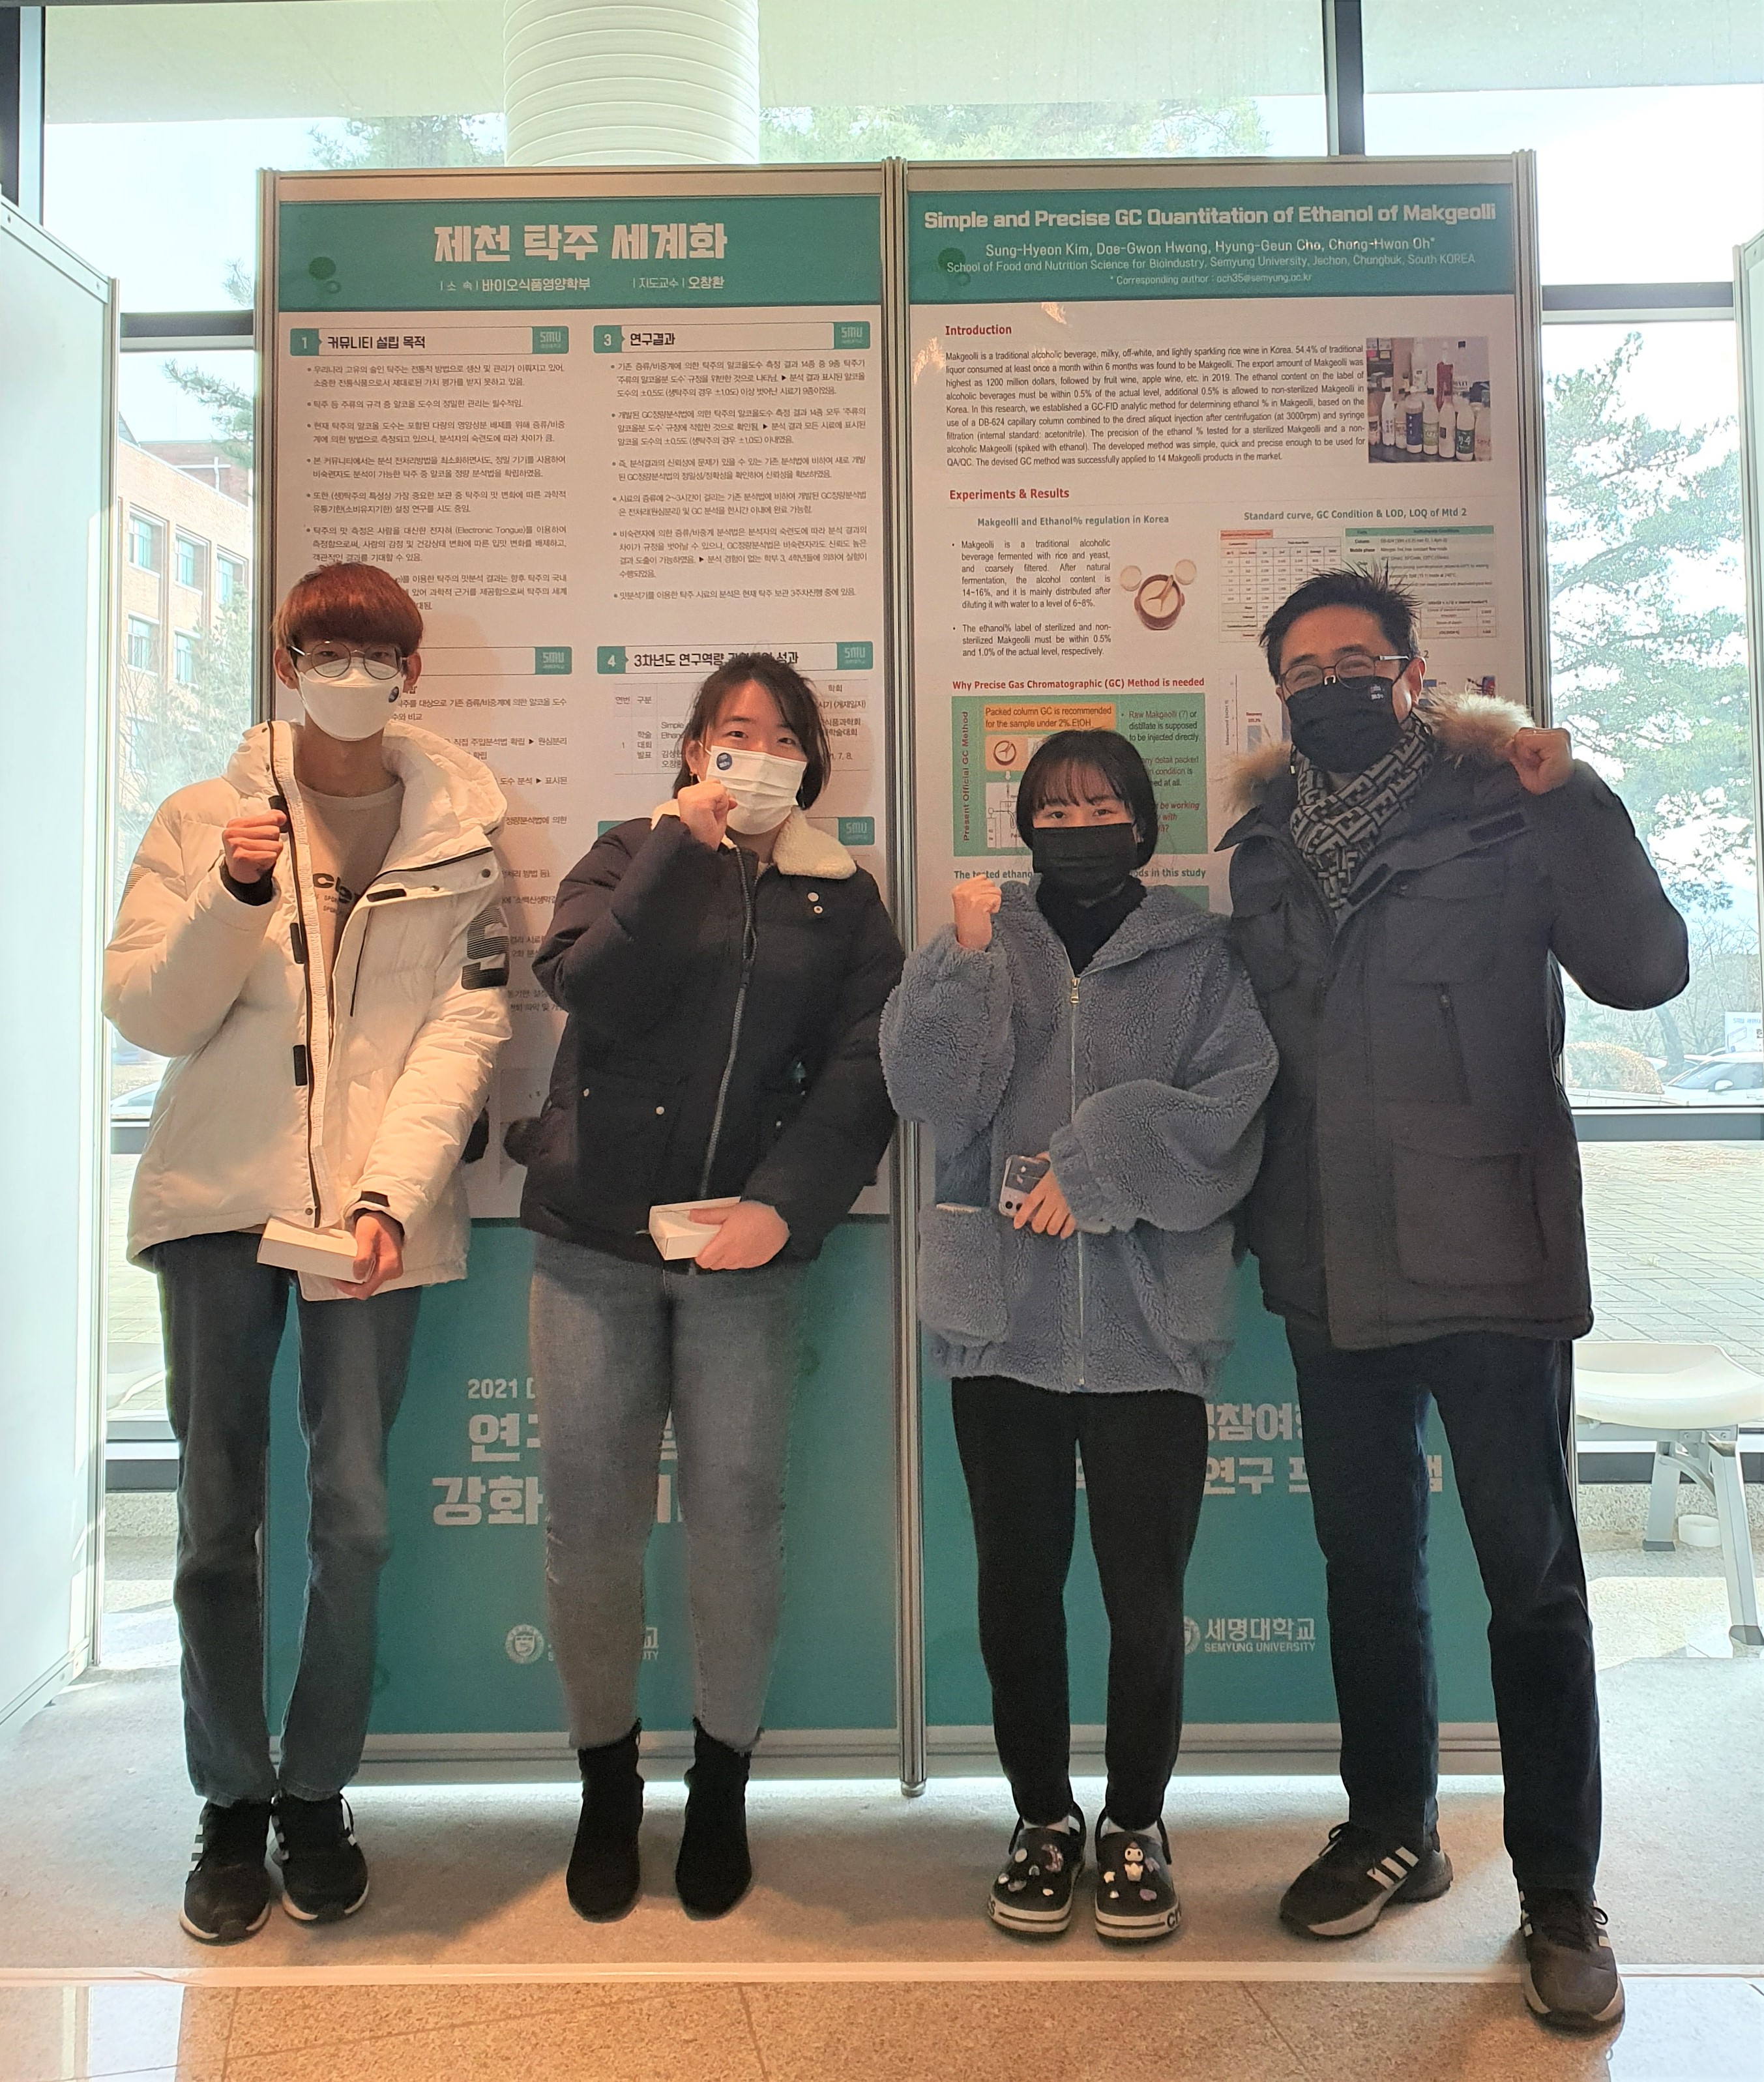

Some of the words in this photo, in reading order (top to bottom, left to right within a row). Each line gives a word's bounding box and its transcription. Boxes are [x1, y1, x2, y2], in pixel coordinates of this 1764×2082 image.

[924, 210, 988, 233] Simple
[993, 209, 1030, 228] and
[1035, 209, 1110, 227] Precise
[1115, 209, 1142, 226] GC
[1147, 206, 1269, 226] Quantitation
[1273, 205, 1294, 224] of
[1299, 204, 1374, 223] Ethanol
[1377, 204, 1398, 222] of
[1403, 203, 1496, 226] Makgeolli
[434, 224, 510, 263] 제천
[524, 224, 598, 261] 탁주
[611, 222, 728, 260] 세계화
[986, 242, 1062, 259] Sung-Hyeon
[1066, 242, 1093, 257] Kim,
[1096, 241, 1162, 256] Dae-Gwon
[1165, 240, 1211, 256] Hwang,
[1215, 239, 1293, 256] Hyung-Geun
[1297, 238, 1325, 252] Cho,
[1329, 237, 1409, 253] Chang-Hwan
[947, 259, 980, 273] School
[982, 260, 993, 272] of
[996, 260, 1022, 272] Food
[1023, 260, 1042, 272] and
[1044, 259, 1088, 272] Nutrition
[1090, 259, 1129, 271] Science
[1132, 258, 1146, 270] for
[1149, 257, 1207, 270] Bioindustry,
[1210, 256, 1256, 269] Semyung
[1257, 256, 1310, 268] University,
[1312, 255, 1350, 267] Jechon,
[1353, 254, 1405, 267] Chungbuk,
[1407, 253, 1437, 265] South
[1439, 252, 1475, 265] KOREA
[447, 280, 456, 291] 소
[481, 277, 591, 292] 바이오식품영양학부
[639, 277, 679, 288] 지도교수
[688, 276, 725, 289] 오창환
[1116, 274, 1179, 286] Corresponding
[1181, 274, 1209, 284] author
[1216, 272, 1313, 284] och35@semyung.ac.kr
[945, 325, 1012, 336] Introduction
[301, 337, 308, 349] 1
[327, 336, 373, 349] 커뮤니티
[376, 336, 399, 350] 설립
[403, 336, 426, 349] 목적
[604, 334, 611, 346] 3
[630, 332, 676, 347] 연구결과
[947, 457, 974, 467] QA/QC.
[975, 458, 990, 467] The
[991, 457, 1018, 467] devised
[1020, 456, 1032, 466] GC
[1033, 455, 1060, 465] method
[1077, 454, 1120, 466] successfully
[1121, 454, 1147, 466] applied
[1148, 454, 1156, 463] to
[1158, 454, 1166, 463] 14
[1168, 453, 1201, 464] Makgeolli
[1203, 452, 1233, 463] products
[1243, 452, 1255, 462] the
[1256, 451, 1283, 461] market.
[950, 488, 1016, 503] Experiments
[1019, 488, 1027, 499] &
[1030, 487, 1070, 499] Results
[1244, 510, 1284, 521] Standard
[1286, 512, 1314, 521] curve,
[1316, 509, 1329, 520] GC
[1331, 508, 1374, 520] Condition
[1376, 508, 1383, 518] &
[1385, 508, 1407, 520] LOD,
[1409, 508, 1428, 520] LOQ
[1430, 507, 1440, 517] of
[1441, 507, 1458, 518] Mtd
[1461, 507, 1467, 517] 2
[977, 517, 1019, 529] Makgeolli
[1021, 516, 1037, 527] and
[1040, 516, 1083, 526] Ethanol%
[1085, 515, 1130, 527] regulation
[1132, 514, 1141, 524] in
[1143, 514, 1169, 524] Korea
[961, 540, 994, 551] Makgeolli
[1004, 540, 1010, 549] is
[1035, 538, 1070, 548] traditional
[1080, 538, 1111, 548] alcoholic
[607, 654, 617, 667] 4
[634, 653, 676, 667] 3차년도
[679, 652, 725, 667] 연구역량
[828, 684, 843, 693] 학회
[952, 680, 972, 692] Why
[974, 680, 1006, 690] Precise
[1008, 680, 1025, 690] Gas
[1027, 678, 1102, 691] Chromatographic
[1104, 678, 1125, 690] (GC)
[1127, 677, 1160, 688] Method
[1162, 677, 1170, 687] is
[1172, 677, 1205, 687] needed
[615, 696, 630, 705] 연번
[637, 696, 652, 705] 구분
[985, 706, 1012, 716] Packed
[1013, 706, 1039, 716] column
[1040, 705, 1053, 716] GC
[1053, 707, 1061, 716] is
[1061, 705, 1112, 716] recommended
[660, 721, 684, 730] Simple
[985, 718, 995, 728] for
[996, 719, 1008, 728] the
[1009, 718, 1035, 729] sample
[1036, 718, 1058, 728] under
[1058, 718, 1072, 728] 2%
[1072, 718, 1093, 730] EtOH
[637, 731, 652, 739] 학술
[637, 751, 652, 759] 발표
[962, 750, 969, 765] GC
[954, 871, 969, 879] The
[1151, 867, 1160, 877] in
[1162, 867, 1179, 878] this
[1181, 868, 1206, 880] study
[467, 1379, 518, 1400] 2021
[1205, 1458, 1274, 1494] 연구
[1205, 1618, 1316, 1641] 세명대학교
[1204, 1641, 1254, 1653] SEMYUNG
[1256, 1641, 1316, 1653] UNIVERSITY
